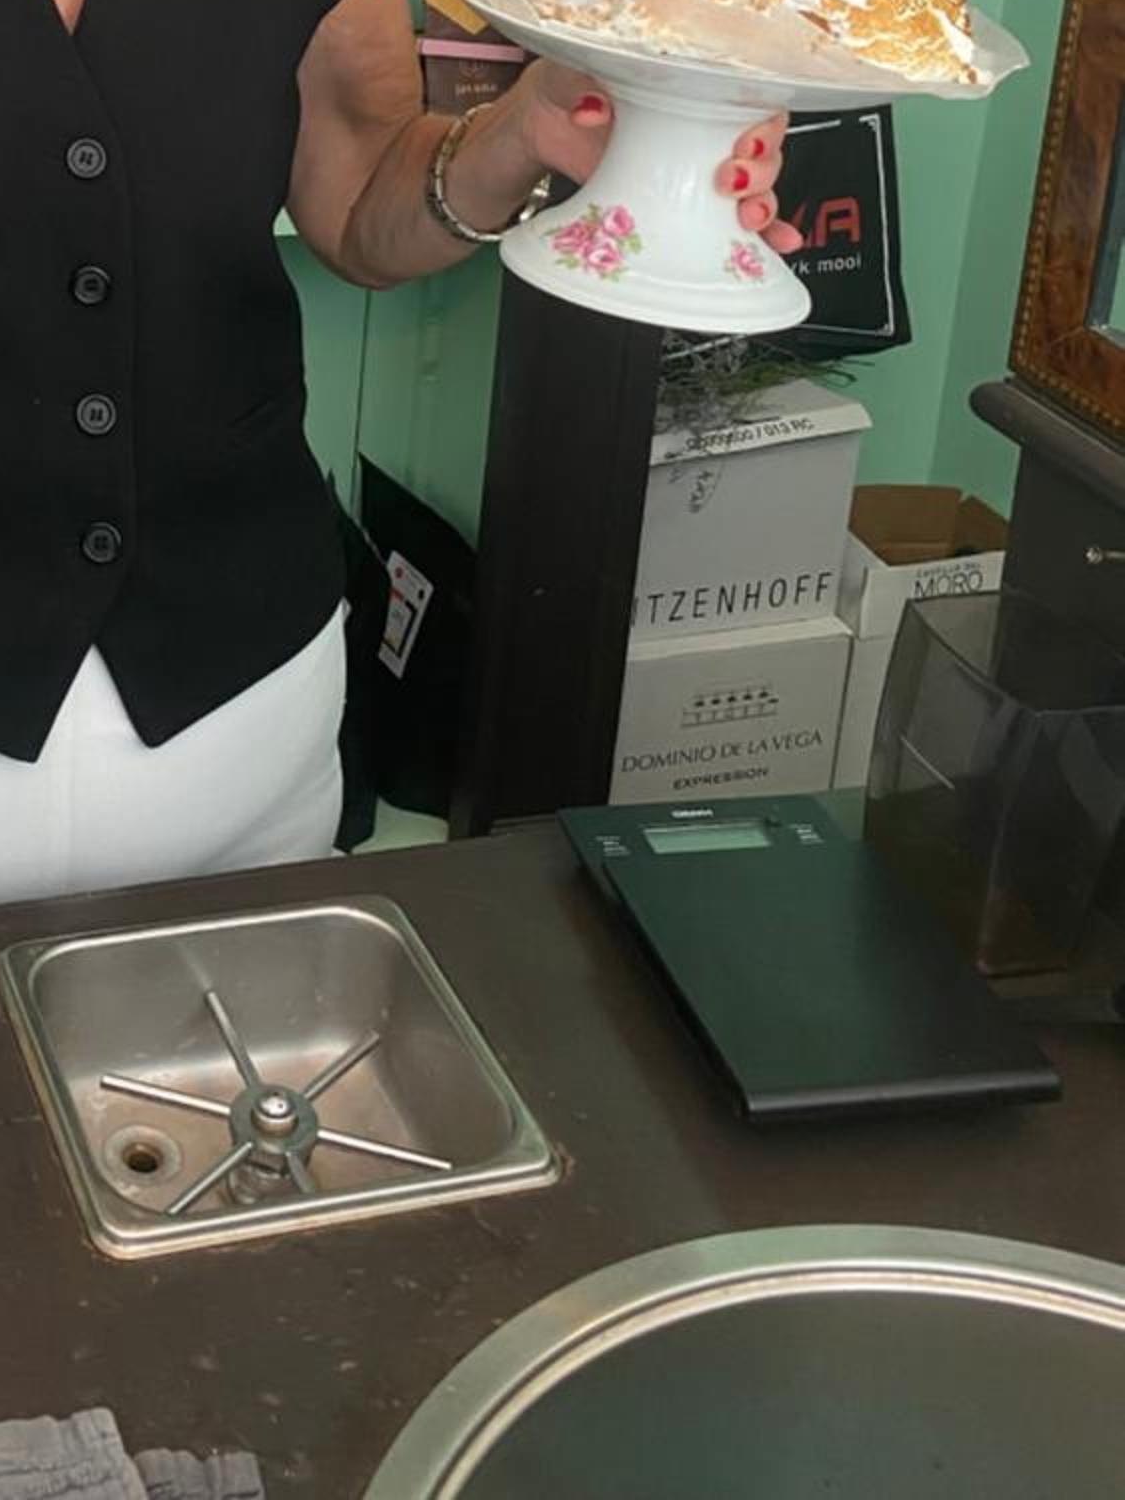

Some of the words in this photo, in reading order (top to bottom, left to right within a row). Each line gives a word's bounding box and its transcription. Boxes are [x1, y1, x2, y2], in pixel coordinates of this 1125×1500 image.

[817, 252, 863, 273] mooi
[915, 571, 984, 599] MORO
[621, 744, 716, 773] DOMINIO
[720, 742, 741, 760] DE
[748, 739, 768, 755] LA
[771, 728, 823, 751] VEGA
[672, 767, 770, 791] EXPRESSION
